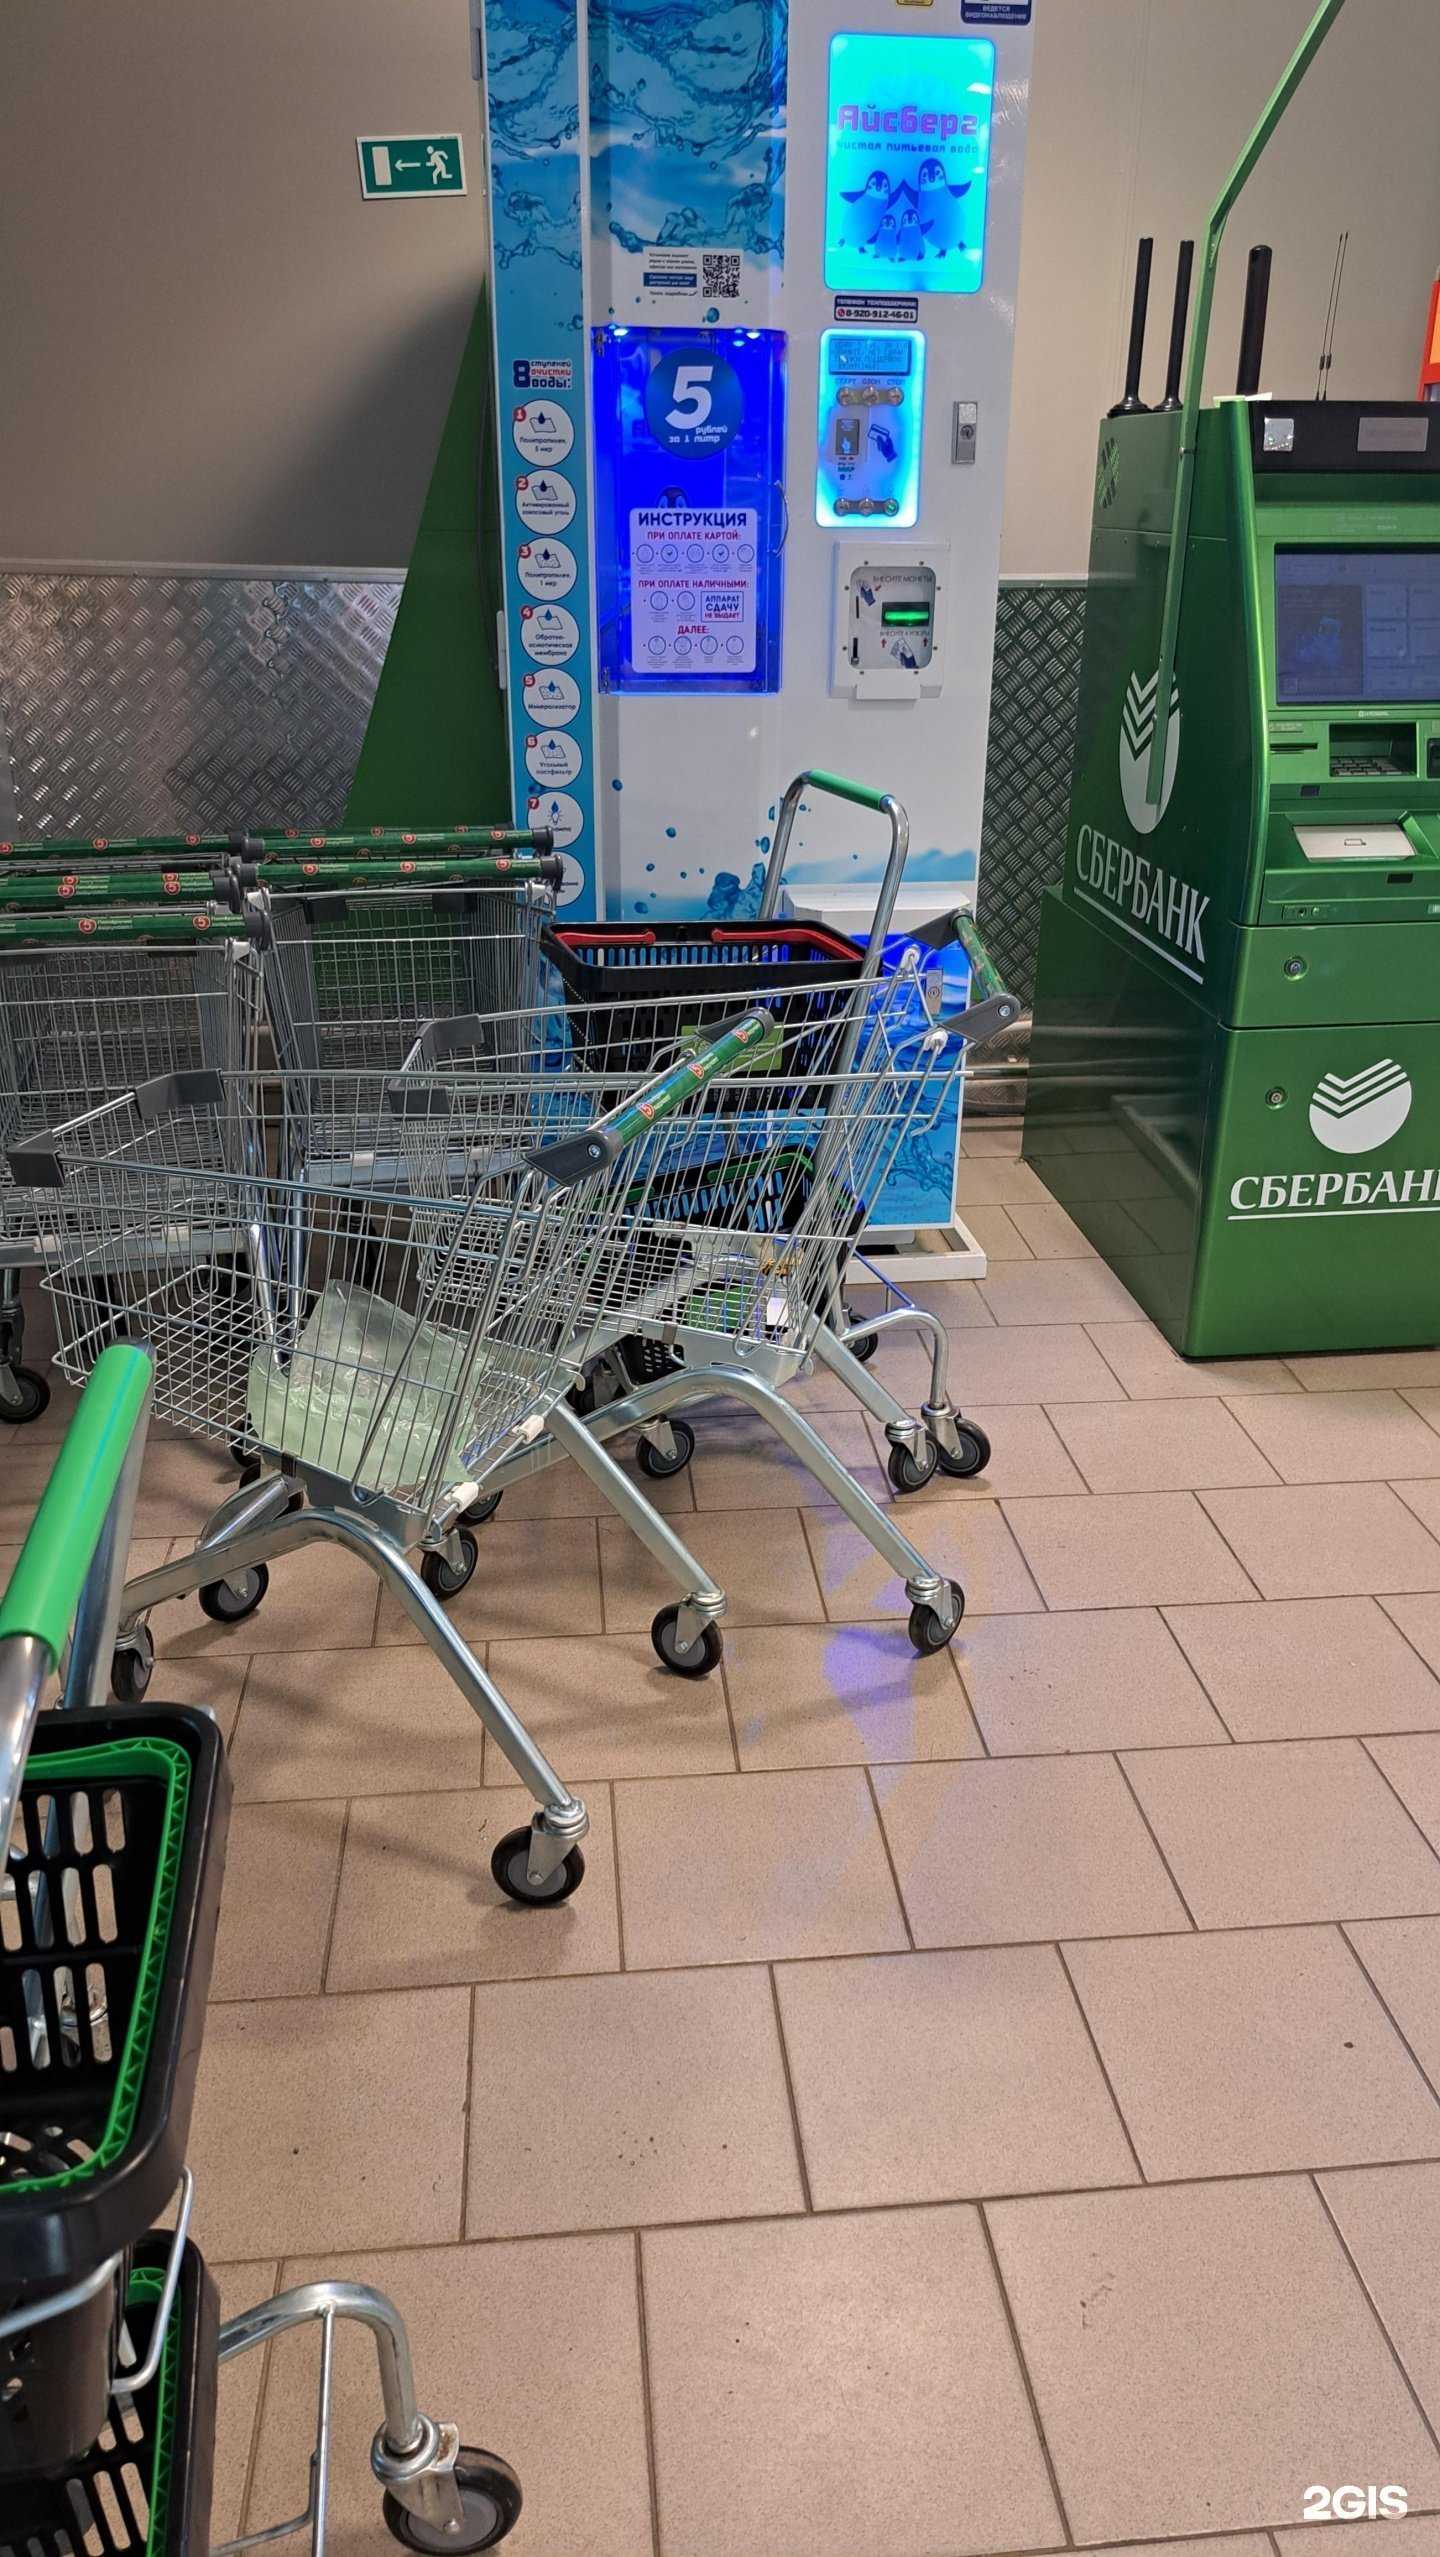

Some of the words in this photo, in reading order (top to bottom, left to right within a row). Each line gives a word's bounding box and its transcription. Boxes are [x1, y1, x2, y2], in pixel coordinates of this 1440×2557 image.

[838, 104, 978, 140] Айсберг
[886, 141, 946, 153] питьевая
[514, 360, 530, 388] 8
[531, 368, 571, 376] очистки
[531, 376, 571, 388] воды:
[665, 366, 713, 429] 5
[695, 424, 728, 435] рублей
[684, 434, 690, 443] 1
[694, 435, 720, 443] литр
[638, 512, 747, 528] ИНСТРУКЦИЯ
[647, 531, 665, 540] ПРИ
[668, 531, 702, 540] ОПЛАТЕ
[704, 529, 741, 540] КАРТОЙ:
[639, 580, 655, 588] ПРИ
[658, 580, 689, 588] ОПЛАТЕ
[692, 580, 749, 588] НАЛИЧНЫМИ:
[705, 603, 740, 612] СДАЧУ
[677, 625, 710, 635] ДАЛЕЕ:
[1076, 824, 1210, 963] СБЕРБАНК
